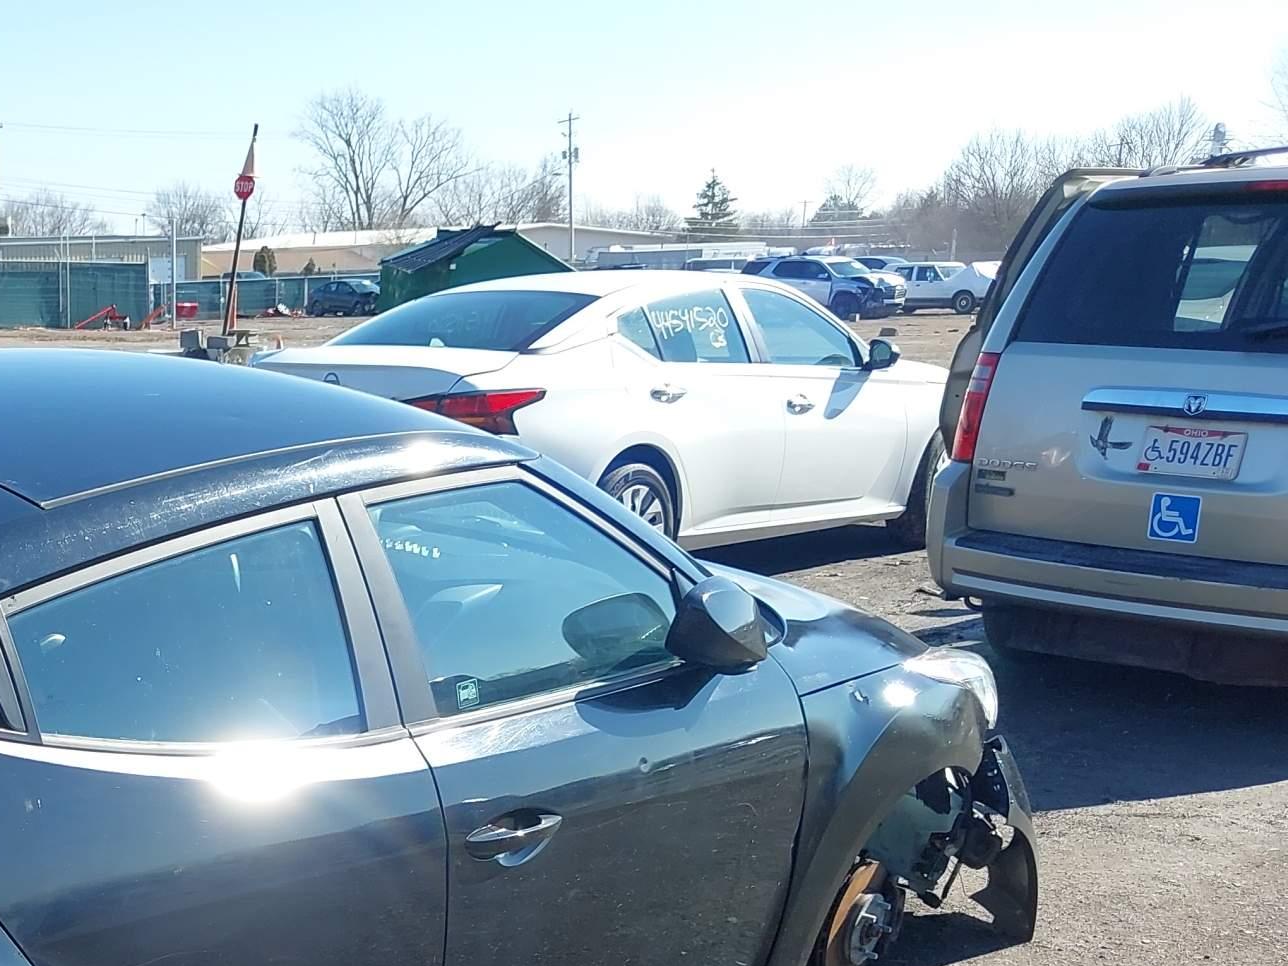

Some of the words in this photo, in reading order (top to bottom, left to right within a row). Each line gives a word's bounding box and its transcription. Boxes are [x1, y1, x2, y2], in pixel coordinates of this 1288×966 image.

[235, 180, 254, 193] STOP
[1183, 429, 1209, 438] OHIO
[1165, 440, 1239, 468] 594ZBF
